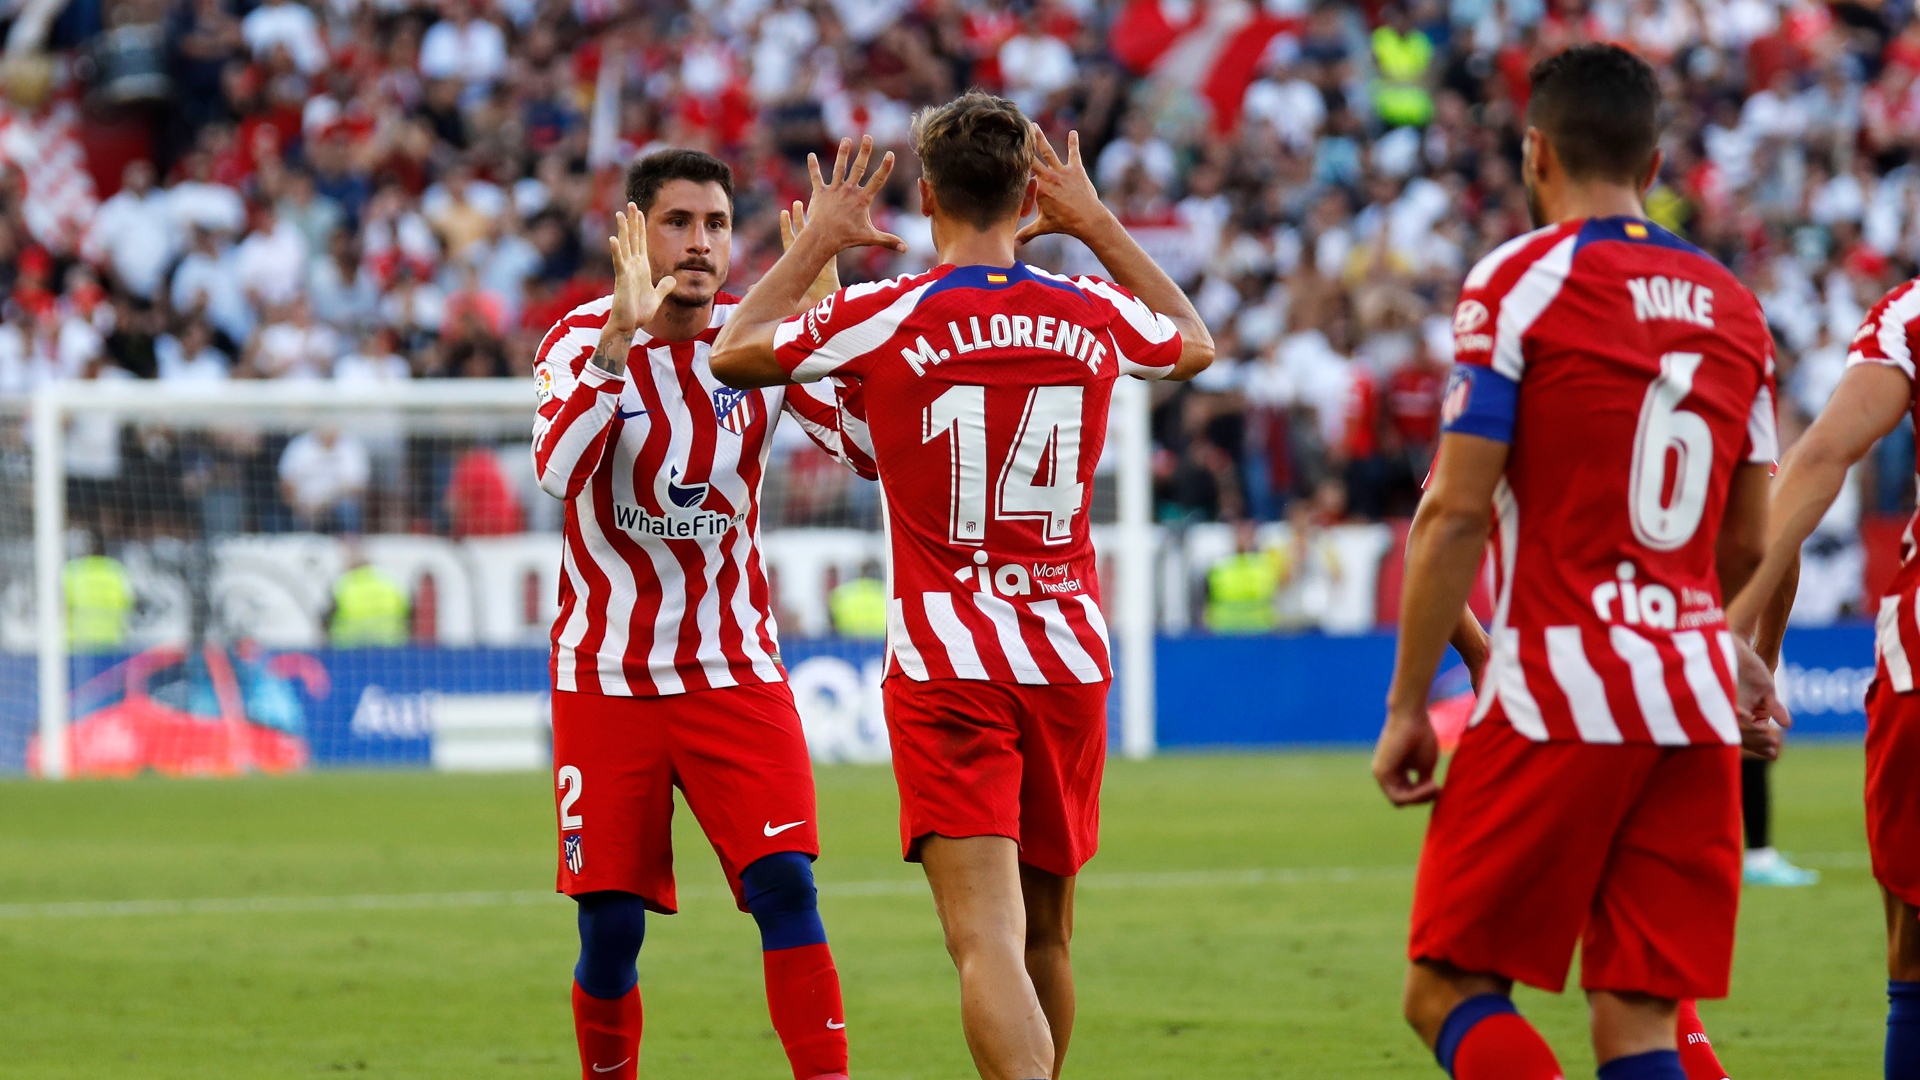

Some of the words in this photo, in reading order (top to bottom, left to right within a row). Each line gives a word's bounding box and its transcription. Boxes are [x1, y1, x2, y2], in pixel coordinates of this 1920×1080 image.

[901, 335, 950, 377] M.
[948, 314, 1107, 375] LLORENTE
[922, 385, 1084, 547] 14
[1628, 352, 1714, 553] 6
[954, 549, 1031, 597] ria
[1033, 562, 1069, 577] Money
[1037, 578, 1081, 594] Transfer
[1592, 560, 1677, 631] ria
[558, 765, 583, 831] 2
